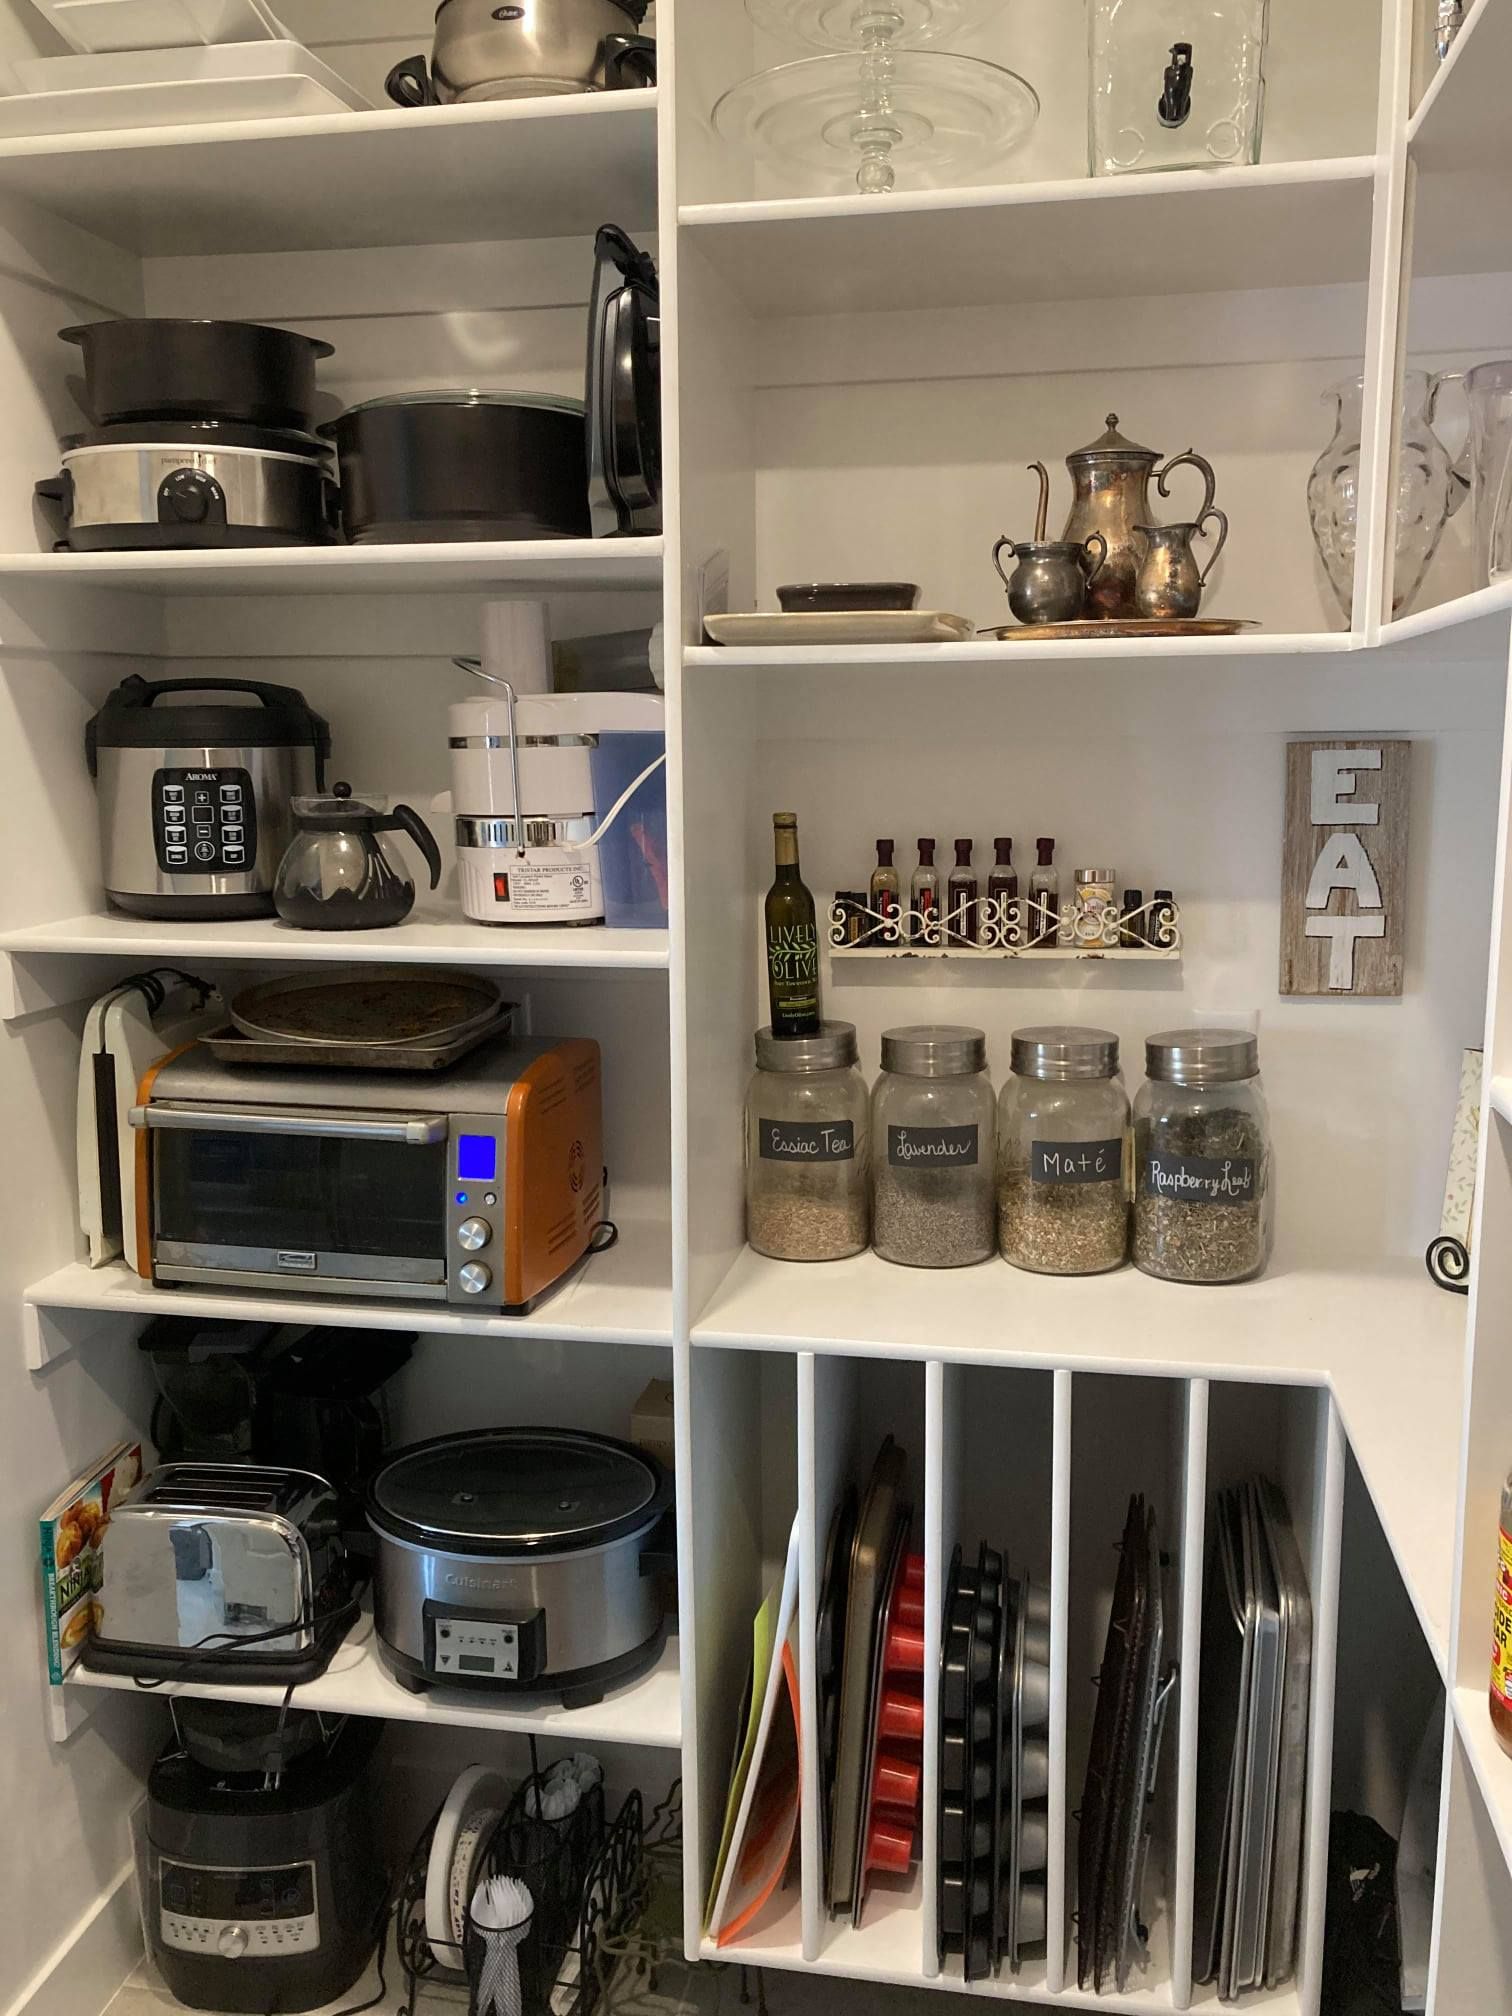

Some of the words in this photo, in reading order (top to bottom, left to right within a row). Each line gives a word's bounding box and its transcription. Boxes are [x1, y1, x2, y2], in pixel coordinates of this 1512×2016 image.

[1304, 749, 1386, 990] EAT
[770, 923, 816, 943] LIVELY
[773, 958, 817, 979] OLIVE
[771, 1128, 819, 1154] Essiac
[821, 1129, 851, 1153] Tea
[897, 1130, 972, 1160] Lavender
[1043, 1149, 1106, 1176] Maté
[1151, 1160, 1219, 1196] Raspberry
[445, 1573, 518, 1591] Cuisinart
